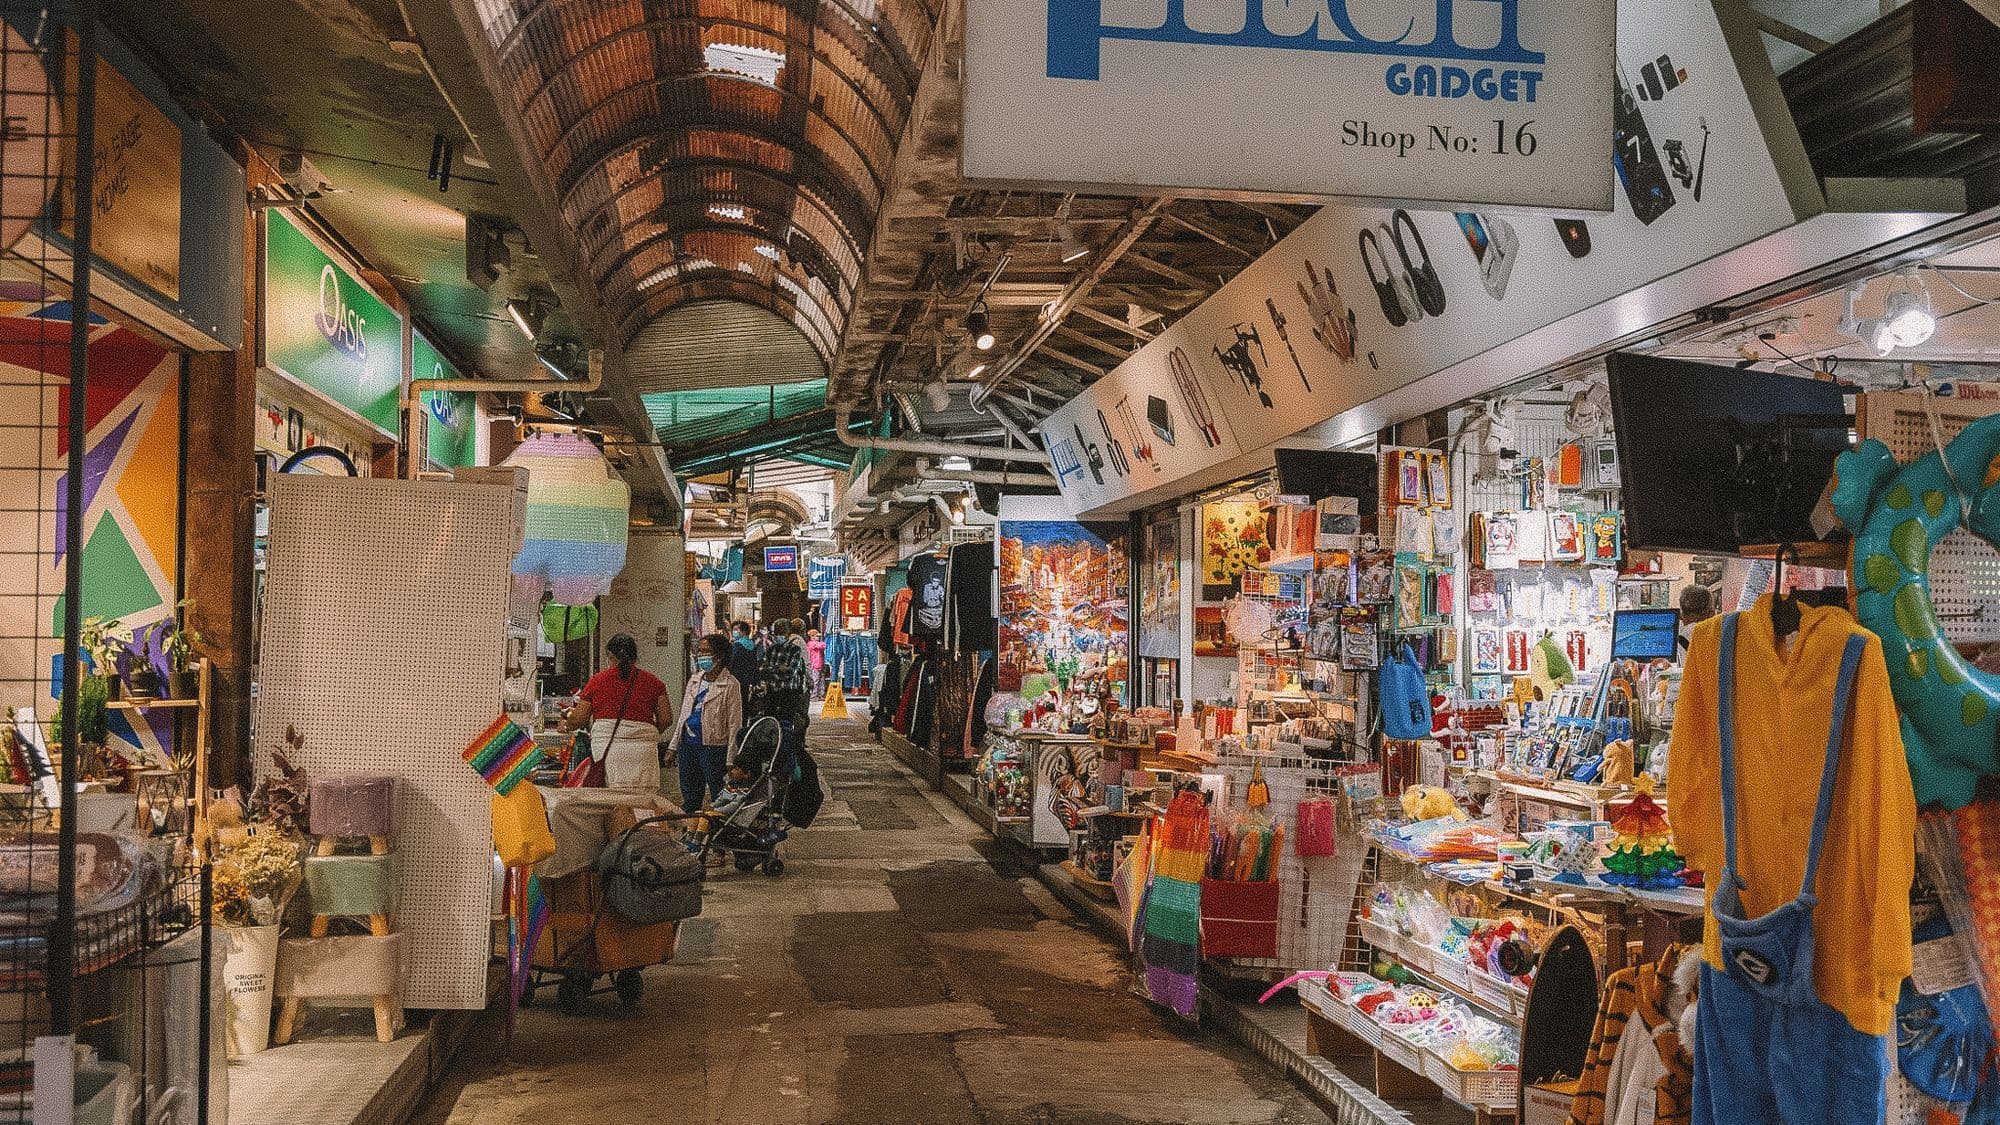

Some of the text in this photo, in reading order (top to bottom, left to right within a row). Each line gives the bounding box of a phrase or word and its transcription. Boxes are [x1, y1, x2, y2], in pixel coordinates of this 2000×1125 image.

[1385, 62, 1544, 102] GADGET
[1340, 119, 1537, 157] Shop No: 16
[320, 264, 367, 360] OASIS
[234, 985, 266, 993] FLOWERS
